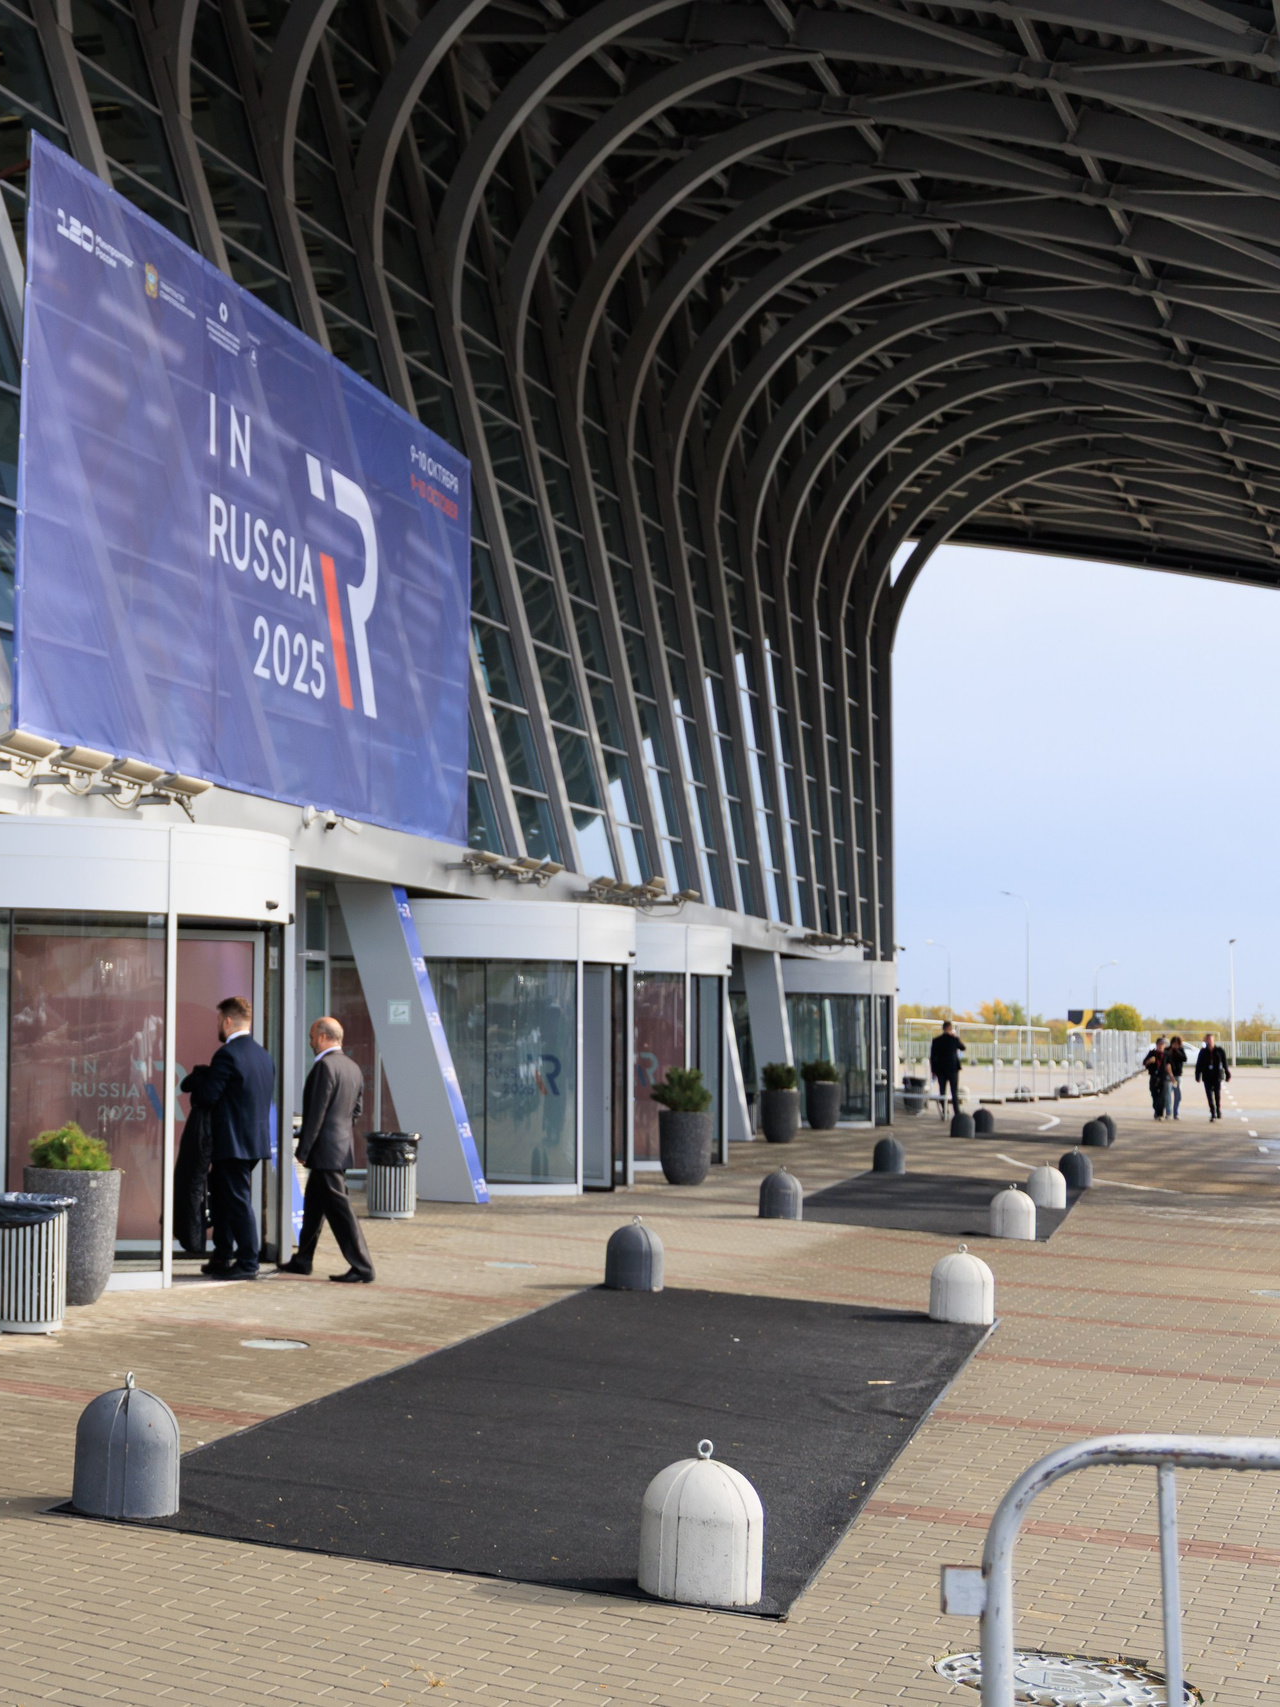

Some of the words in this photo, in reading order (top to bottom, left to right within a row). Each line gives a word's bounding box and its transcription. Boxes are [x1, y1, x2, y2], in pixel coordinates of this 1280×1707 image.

[209, 392, 251, 478] IN
[209, 492, 317, 606] RUSSIA
[253, 614, 326, 700] 2025
[71, 1081, 140, 1098] RUSSIA
[97, 1105, 146, 1121] 2025
